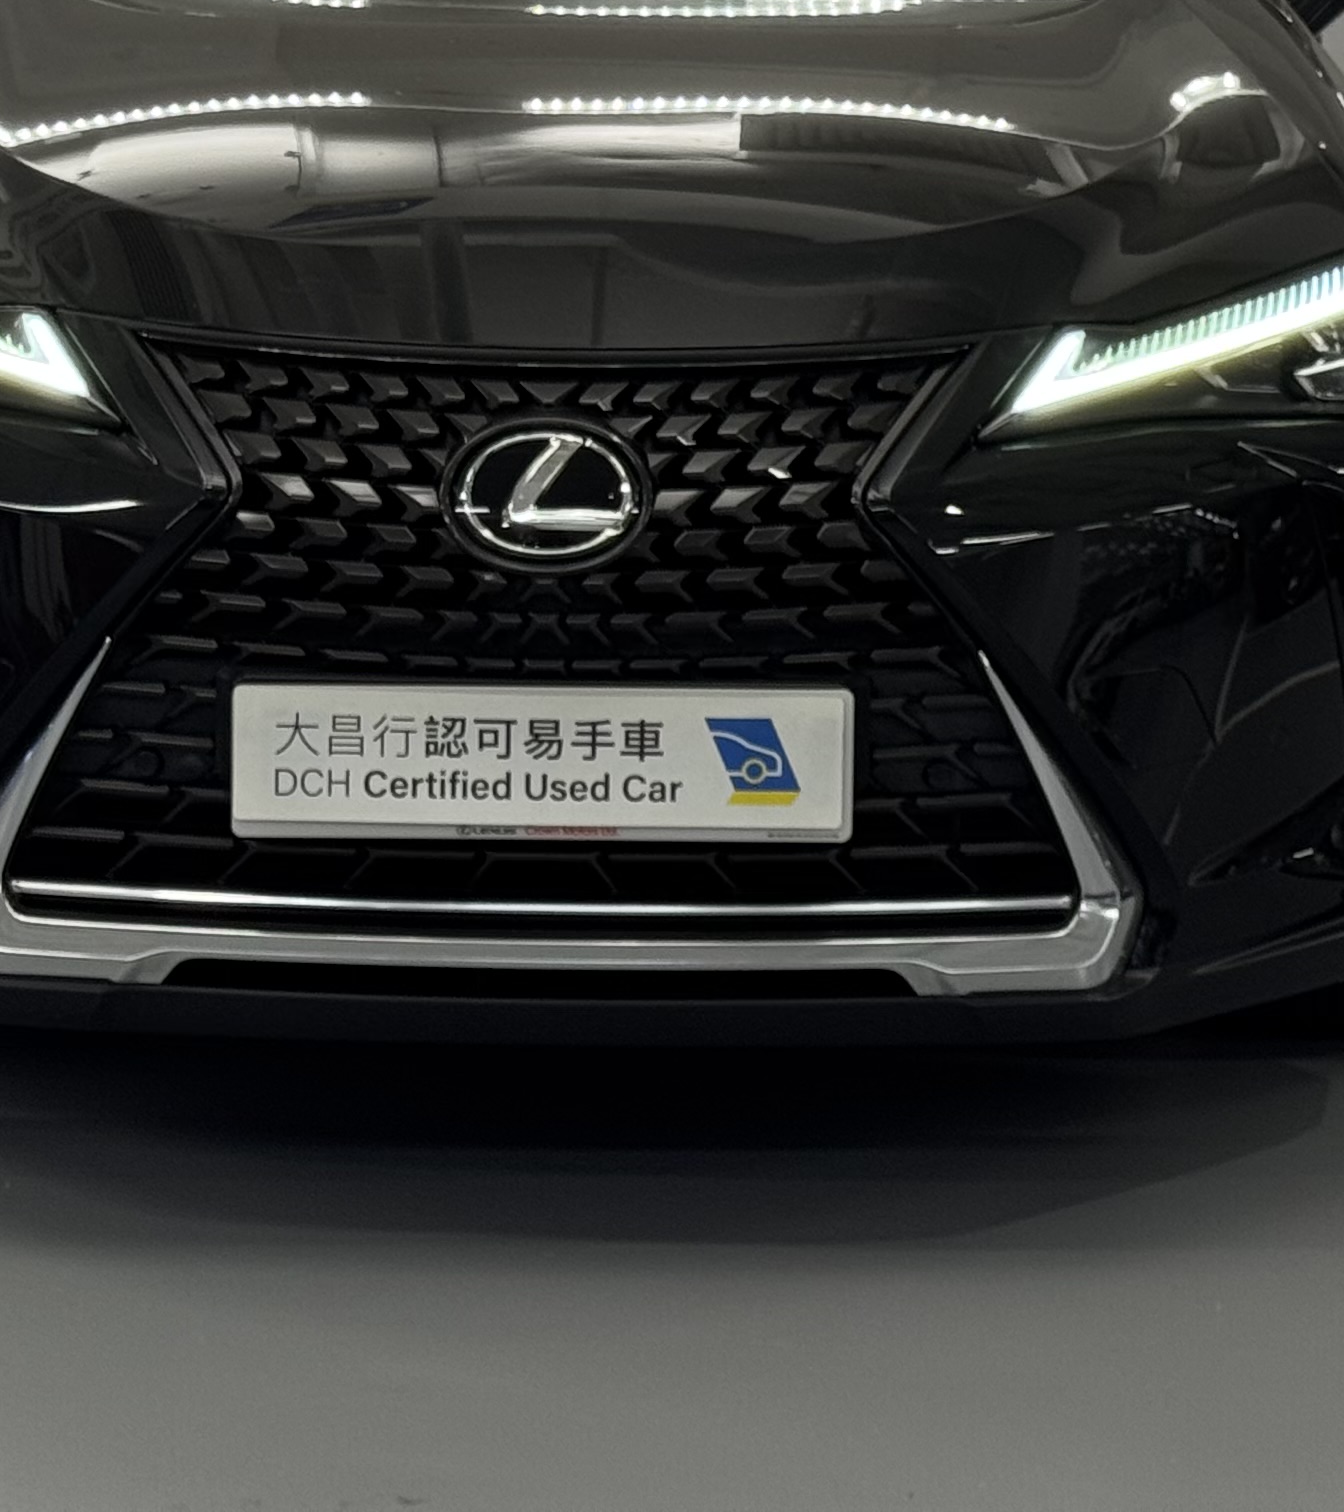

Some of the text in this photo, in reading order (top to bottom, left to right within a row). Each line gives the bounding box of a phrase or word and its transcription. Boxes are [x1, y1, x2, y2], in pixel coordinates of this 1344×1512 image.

[274, 712, 666, 763] 大昌行認可易手車
[274, 768, 684, 805] DCH Certified Used Car
